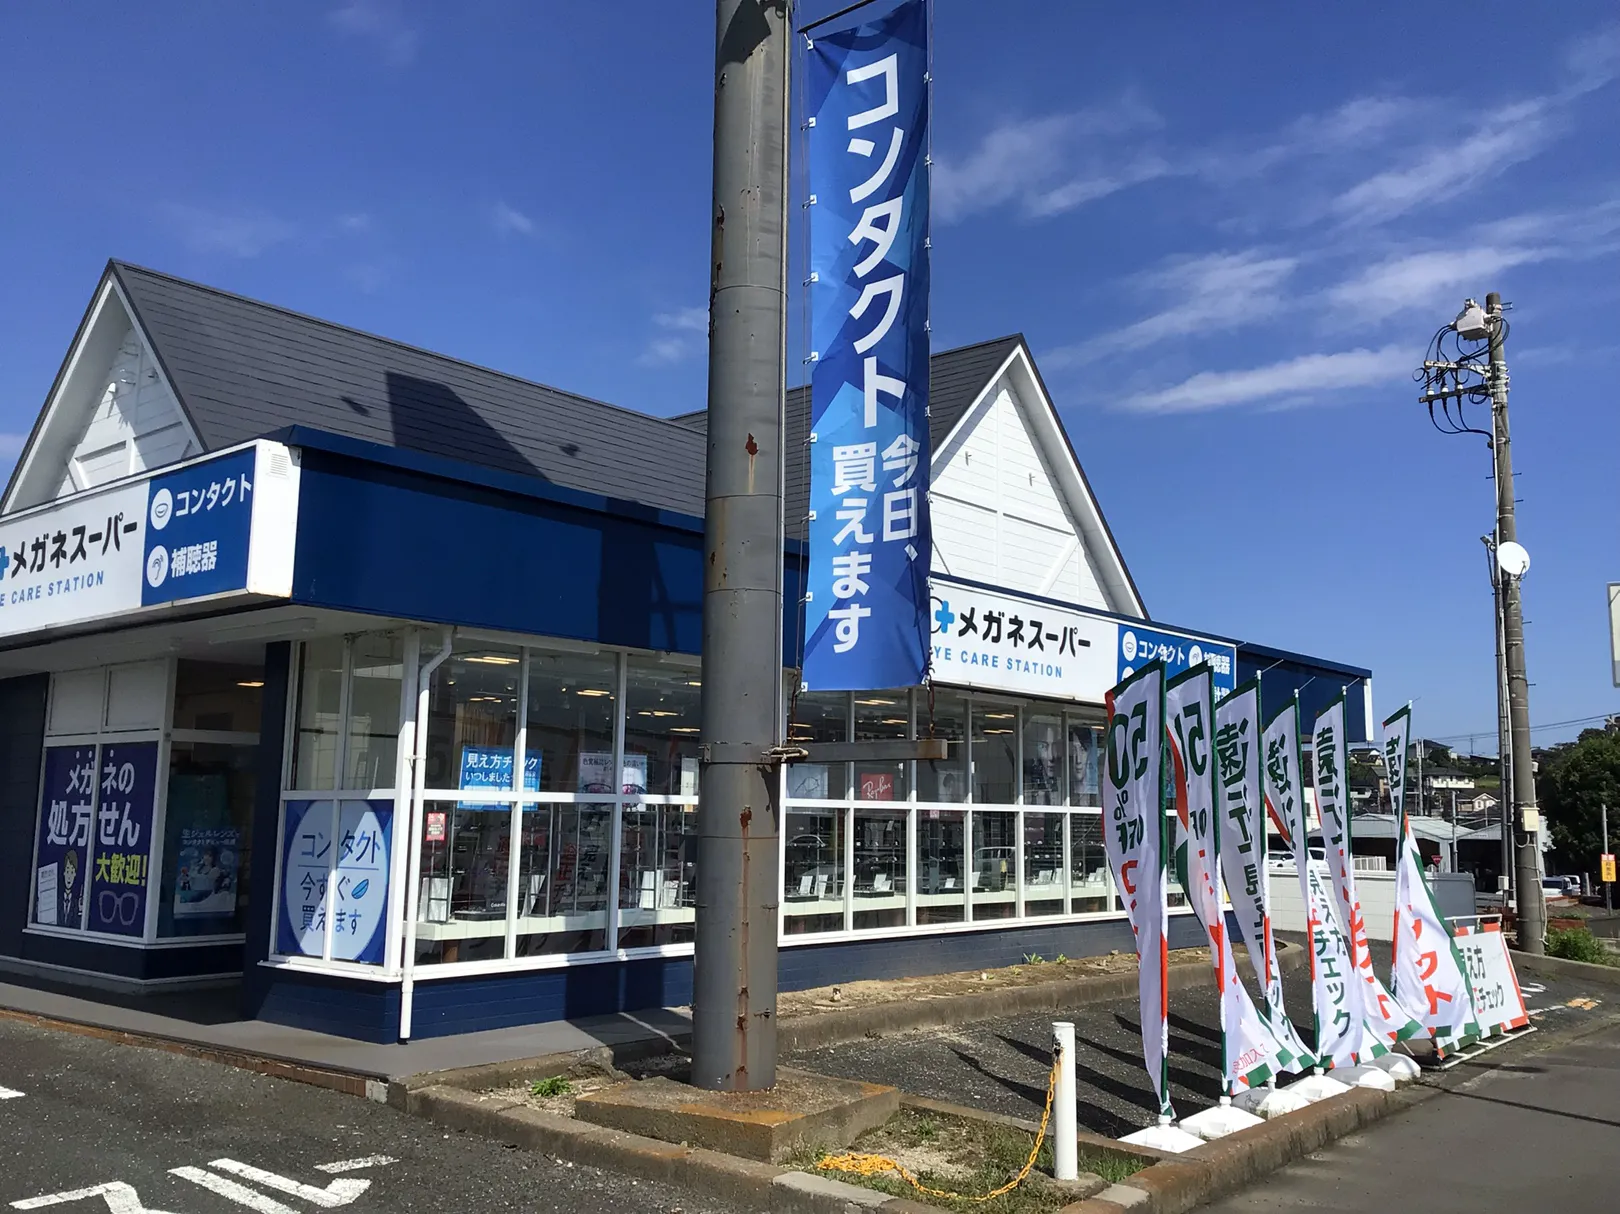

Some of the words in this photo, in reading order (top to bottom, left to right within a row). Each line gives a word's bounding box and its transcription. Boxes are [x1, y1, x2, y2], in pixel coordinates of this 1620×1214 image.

[847, 53, 906, 428] コンタクト
[175, 473, 252, 516] コンタクト
[881, 434, 920, 562] 今日、
[11, 512, 137, 578] メガネスーパー
[170, 540, 218, 578] 補聴器
[828, 442, 877, 653] 買えます
[11, 585, 42, 605] CARE
[48, 571, 104, 597] STATION
[958, 607, 1091, 658] メガネスーパー
[934, 645, 952, 661] YE
[961, 651, 999, 668] CARE
[1006, 658, 1063, 679] STATION
[1138, 640, 1185, 666] コンタクト
[65, 761, 135, 795] メガネの
[465, 771, 512, 783] いつしました
[466, 753, 538, 769] 見え方チク
[47, 799, 140, 847] 処方せん
[301, 829, 381, 864] コンタクト
[95, 852, 148, 887] 大歓迎!
[300, 871, 351, 901] 今すぐ
[300, 904, 362, 935] 買えます
